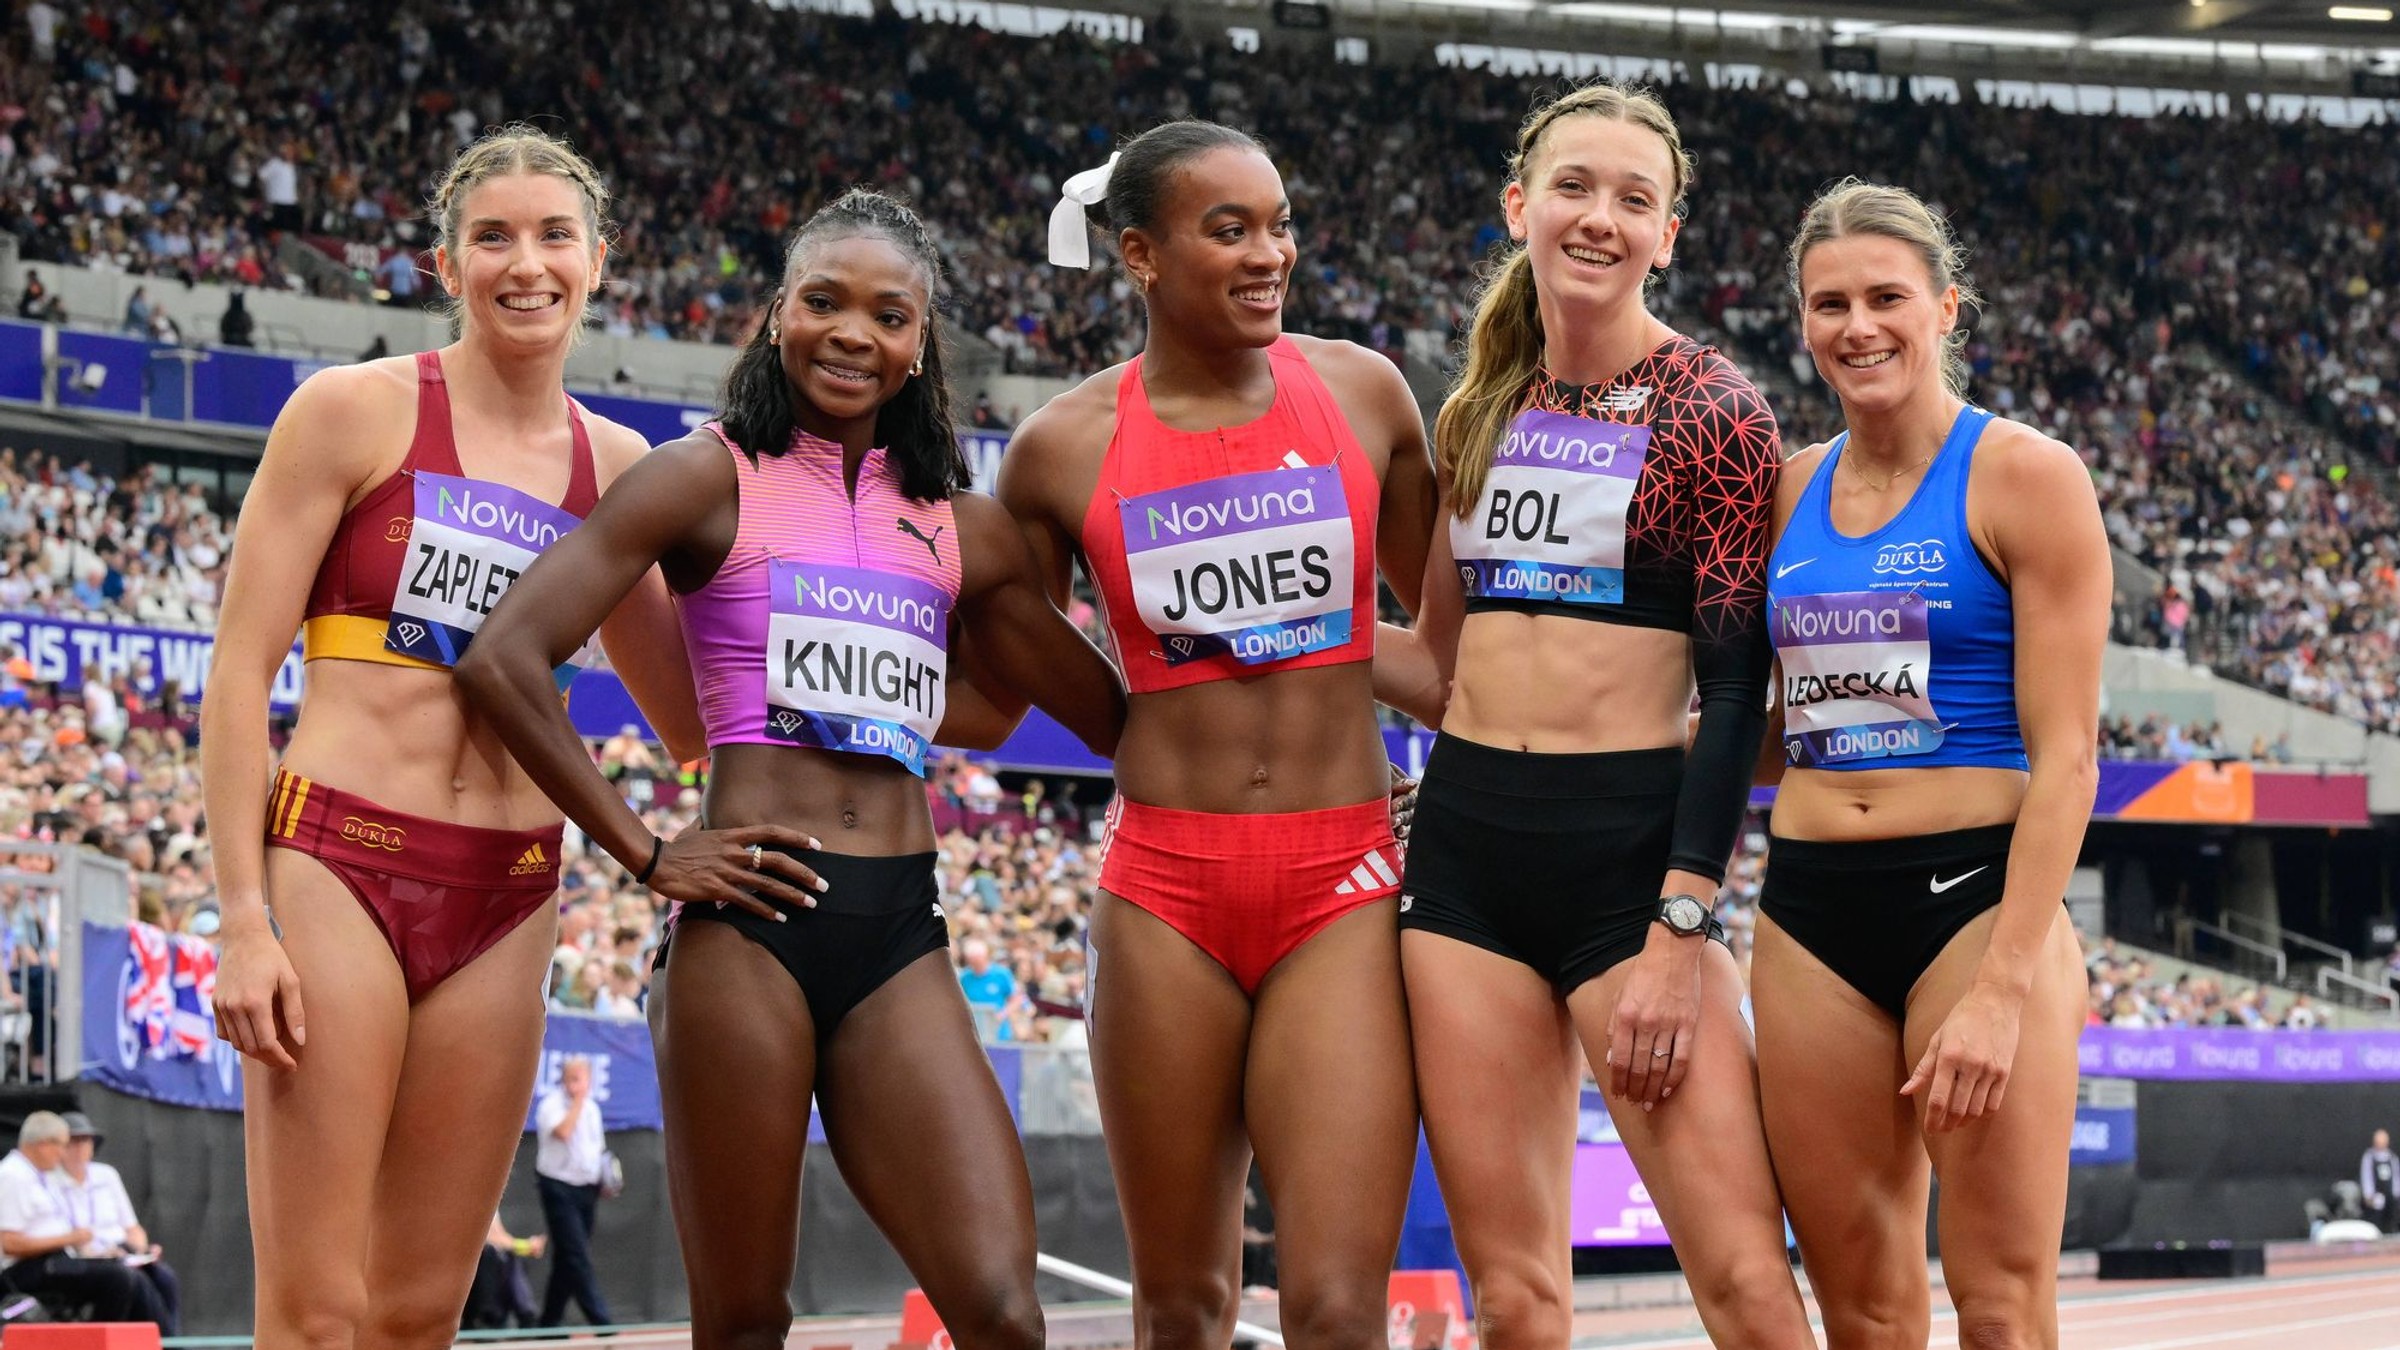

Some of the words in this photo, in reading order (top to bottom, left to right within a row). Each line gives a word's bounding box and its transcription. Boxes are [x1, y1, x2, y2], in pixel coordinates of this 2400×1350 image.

[1497, 430, 1617, 468] ovuna
[437, 485, 568, 547] Novun
[1147, 488, 1315, 541] Novuna
[1486, 489, 1570, 545] BOL
[1876, 549, 1945, 567] DUKLA
[1162, 544, 1332, 622] JONES
[1493, 568, 1592, 595] LONDON
[794, 574, 936, 635] Novuna
[1781, 604, 1901, 639] Novuna
[1230, 622, 1327, 658] LONDON
[784, 638, 940, 720] KNIGHT
[1787, 663, 1920, 707] LEDECKÁ
[850, 723, 919, 763] LONDON
[1826, 727, 1920, 757] LONDON
[343, 823, 402, 846] DUKLA
[509, 860, 551, 876] adidas
